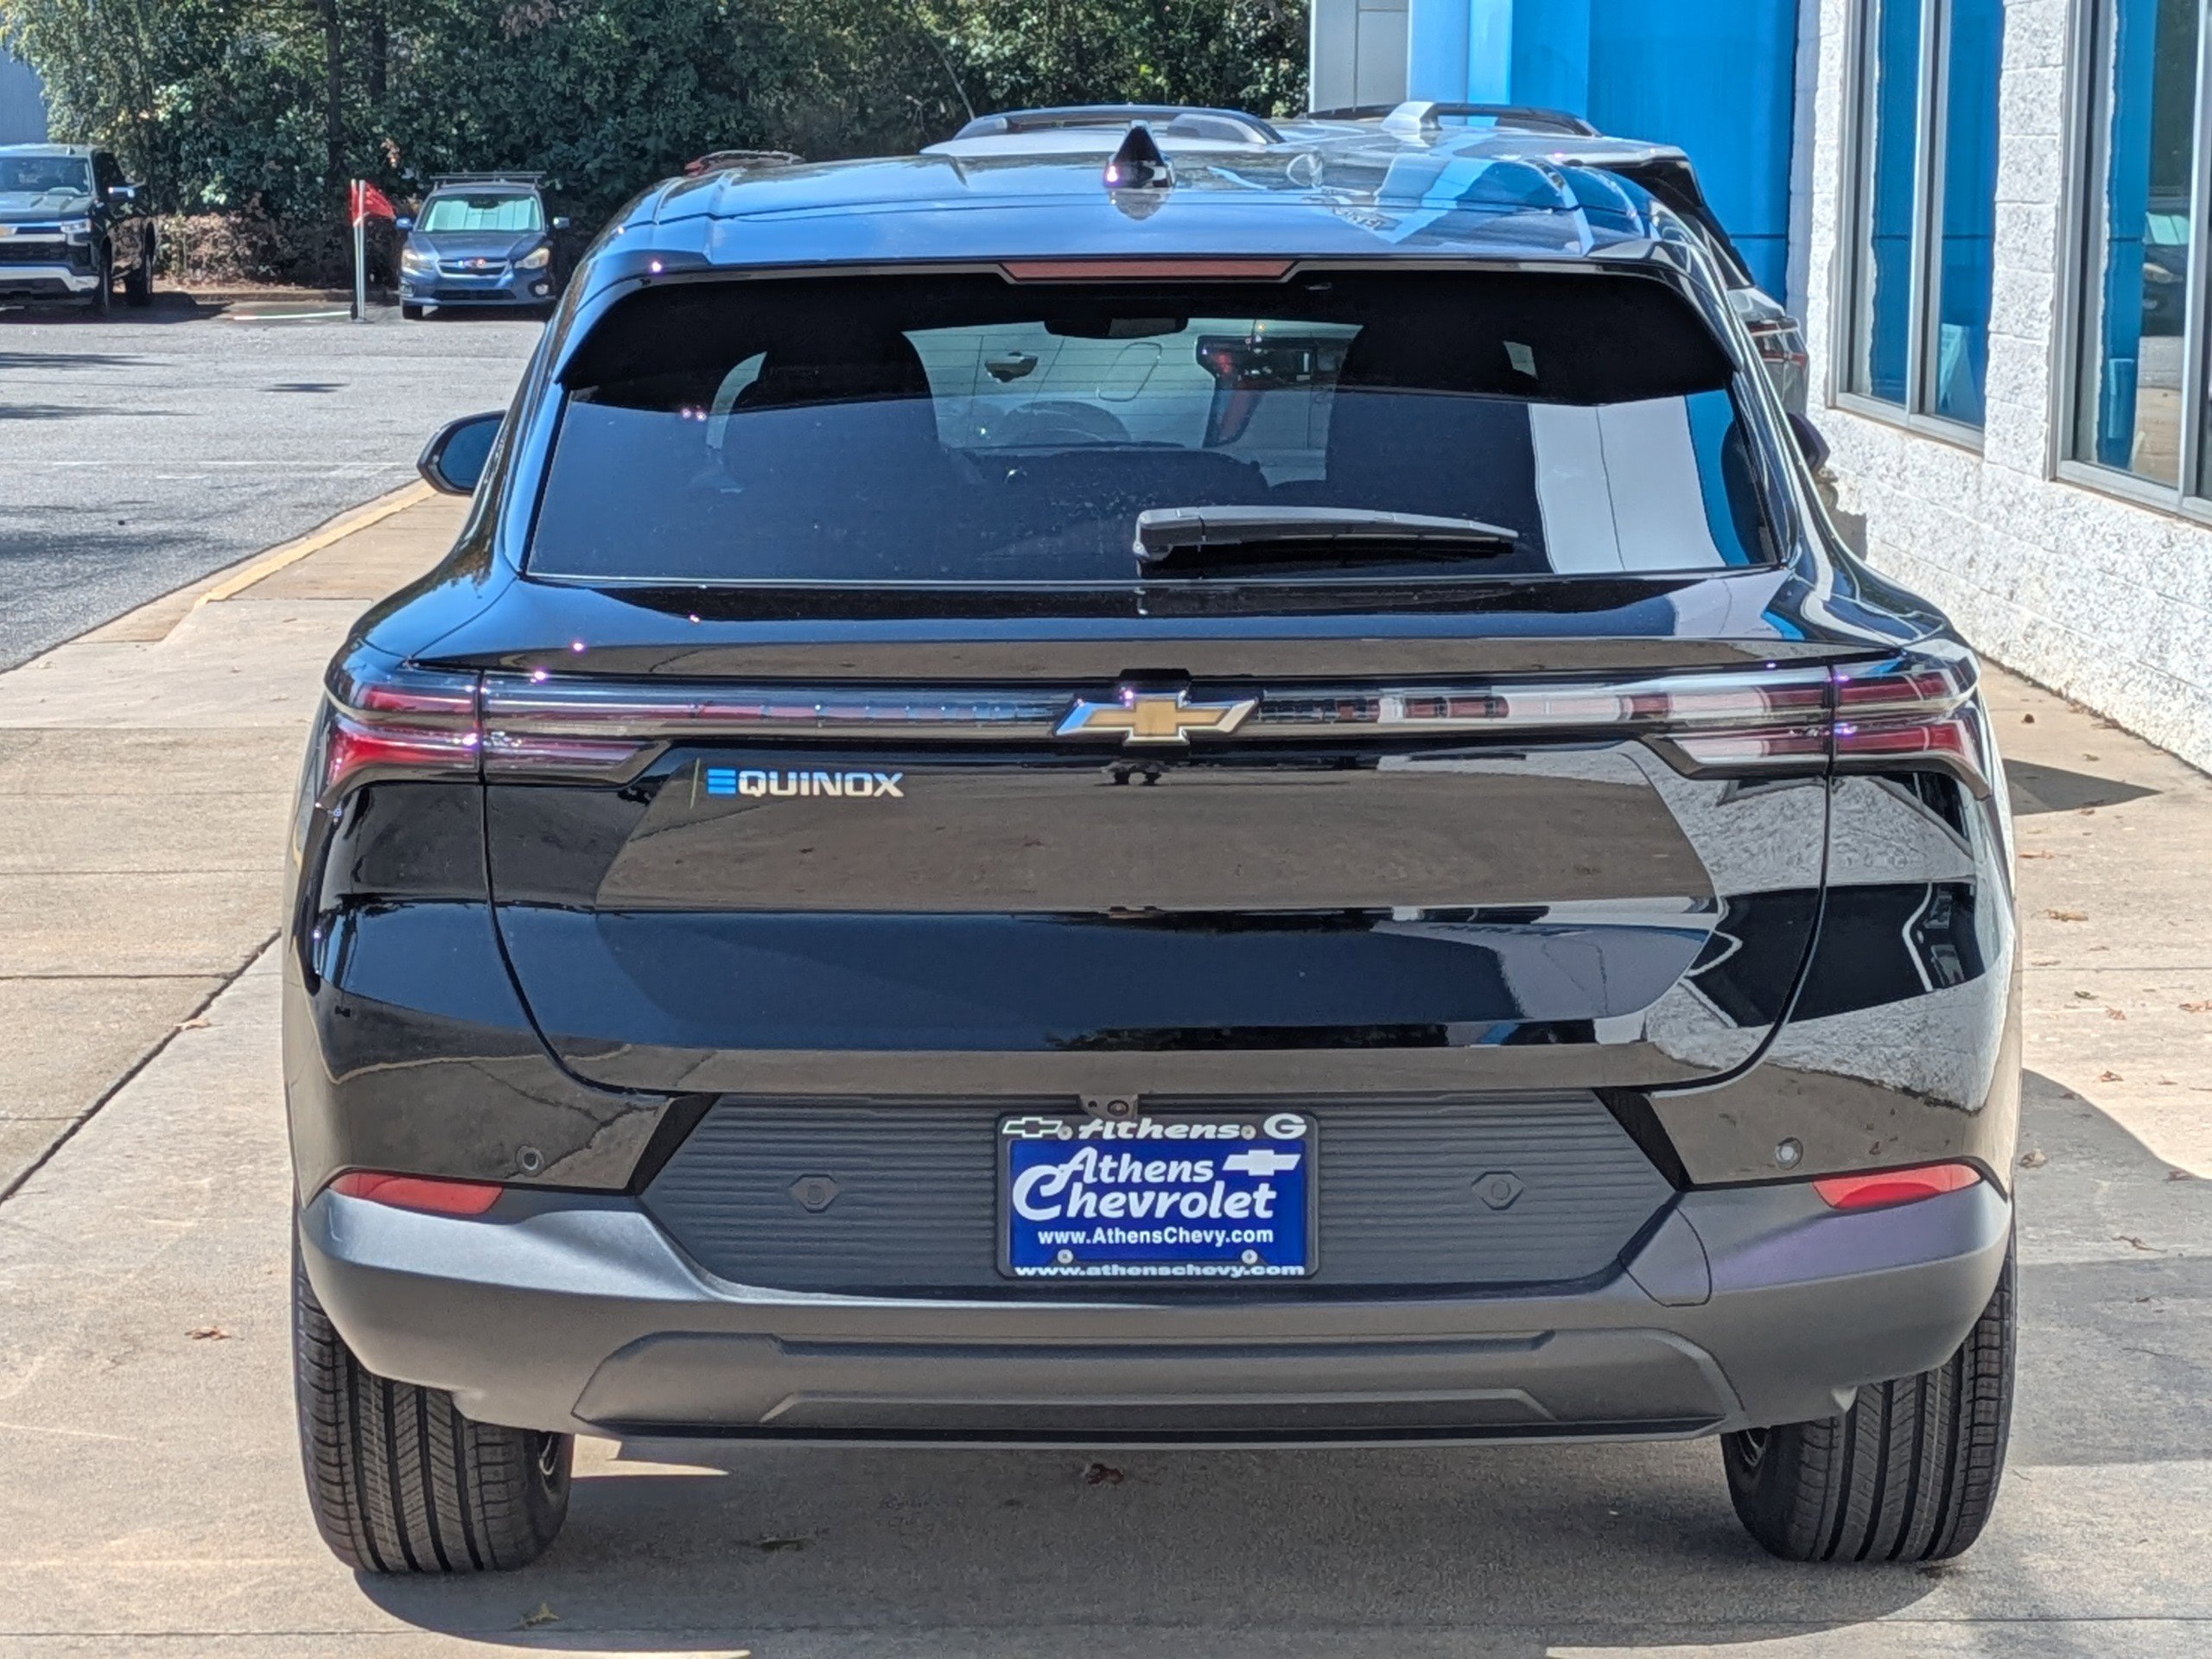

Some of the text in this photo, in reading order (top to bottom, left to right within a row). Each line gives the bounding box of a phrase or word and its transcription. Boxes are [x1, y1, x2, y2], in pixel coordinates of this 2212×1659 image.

[708, 769, 905, 797] EQUINOX
[1078, 1117, 1240, 1140] Athens
[1263, 1113, 1307, 1140] G
[1058, 1146, 1214, 1184] Athens
[1012, 1164, 1277, 1221] Chevrolet
[1037, 1226, 1274, 1248] www.AthensChevy.com
